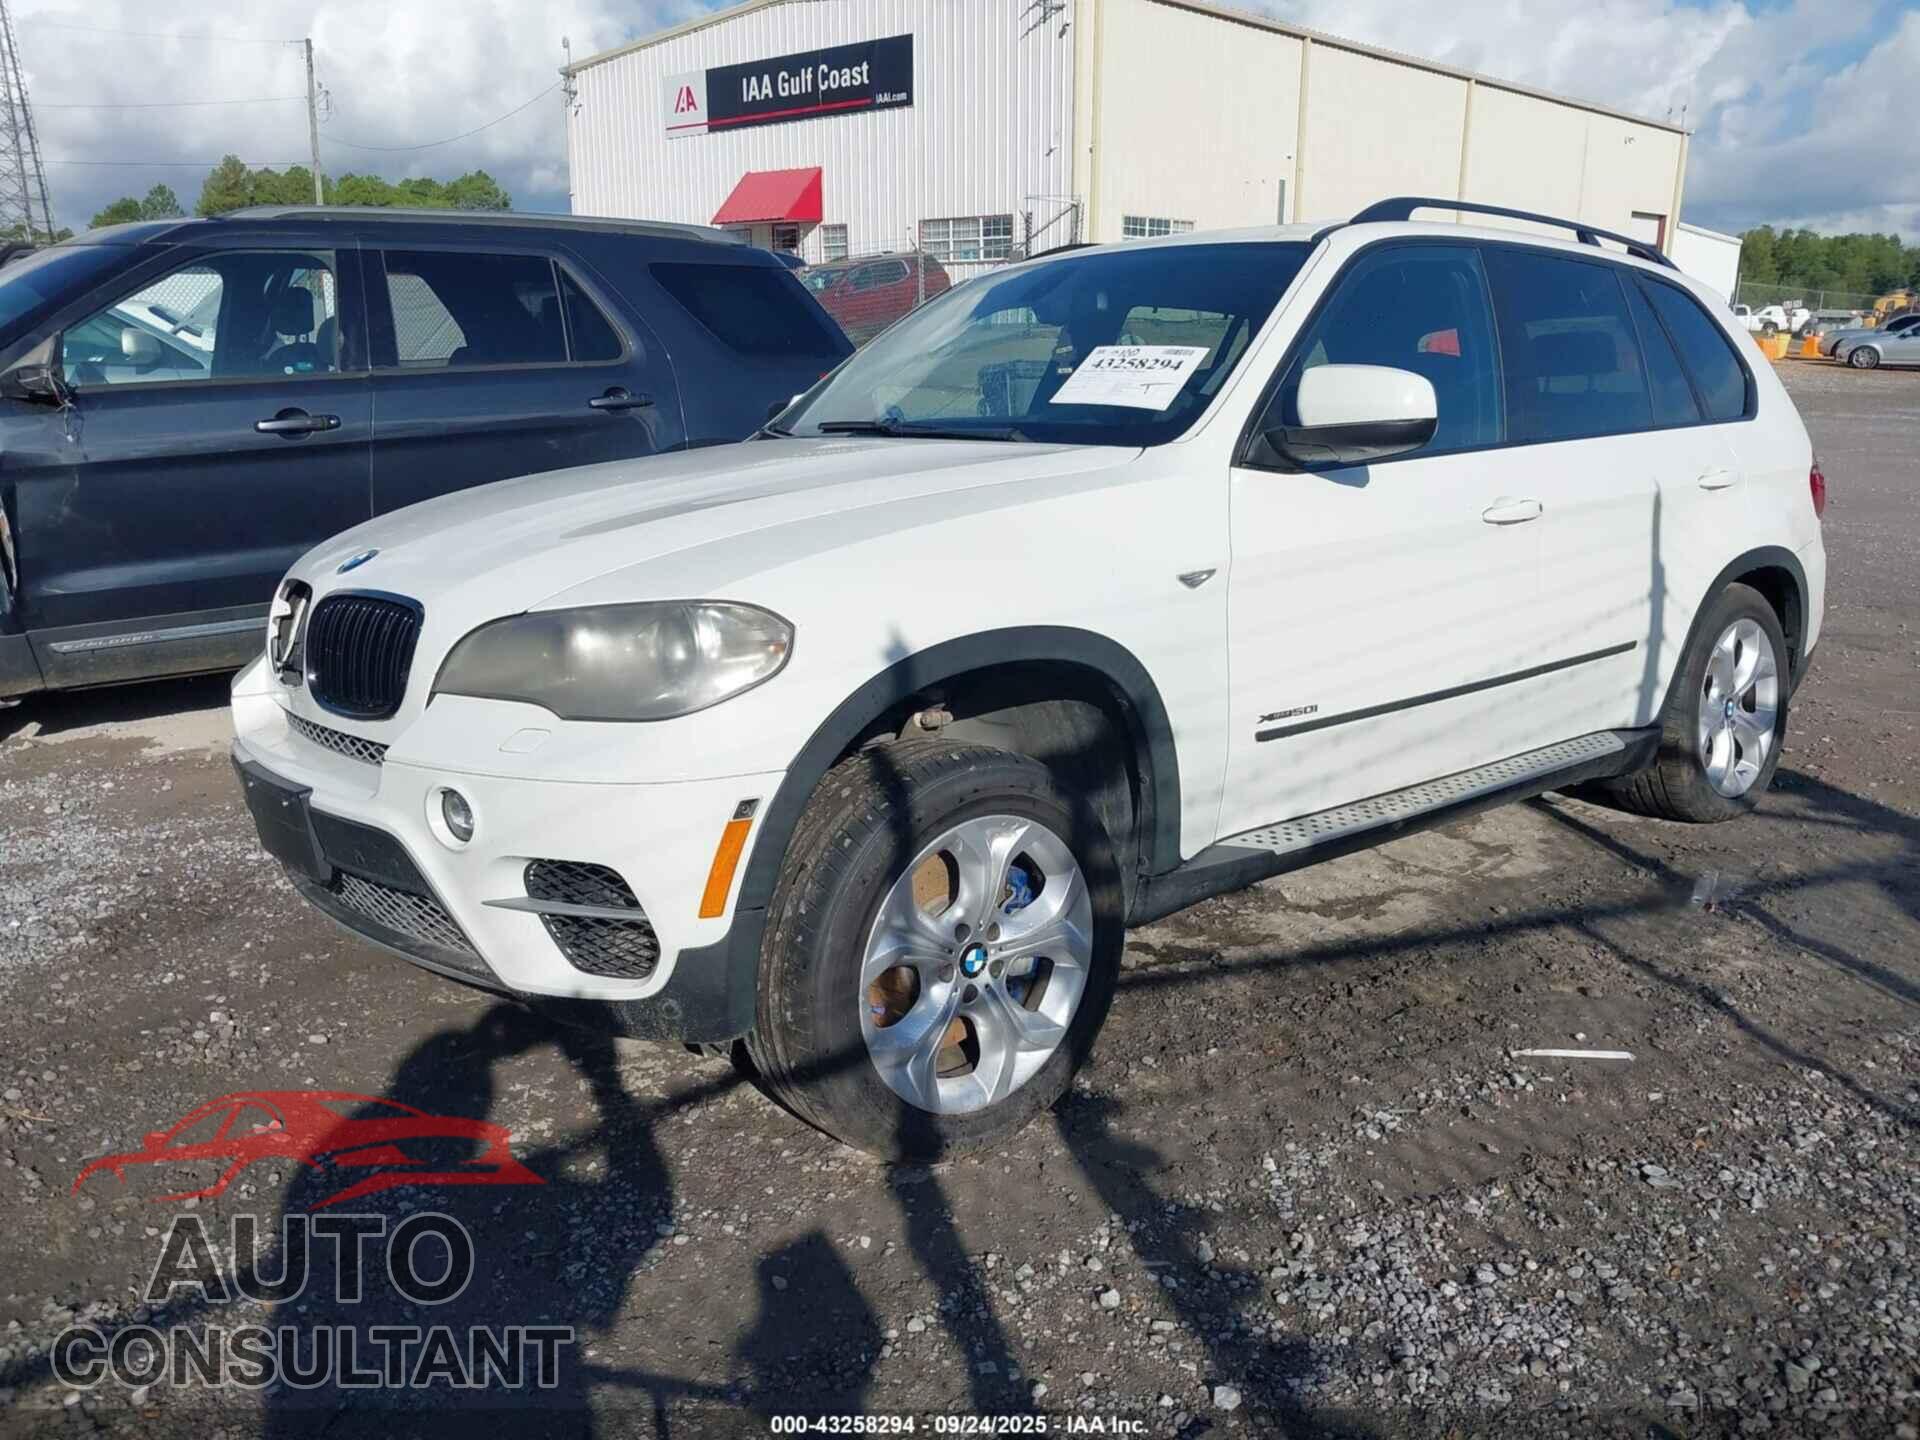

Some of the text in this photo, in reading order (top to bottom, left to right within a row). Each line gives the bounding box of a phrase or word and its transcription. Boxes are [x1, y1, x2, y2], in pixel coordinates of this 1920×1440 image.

[742, 60, 869, 102] IAA Gulf Coast
[1092, 357, 1185, 371] 43258294
